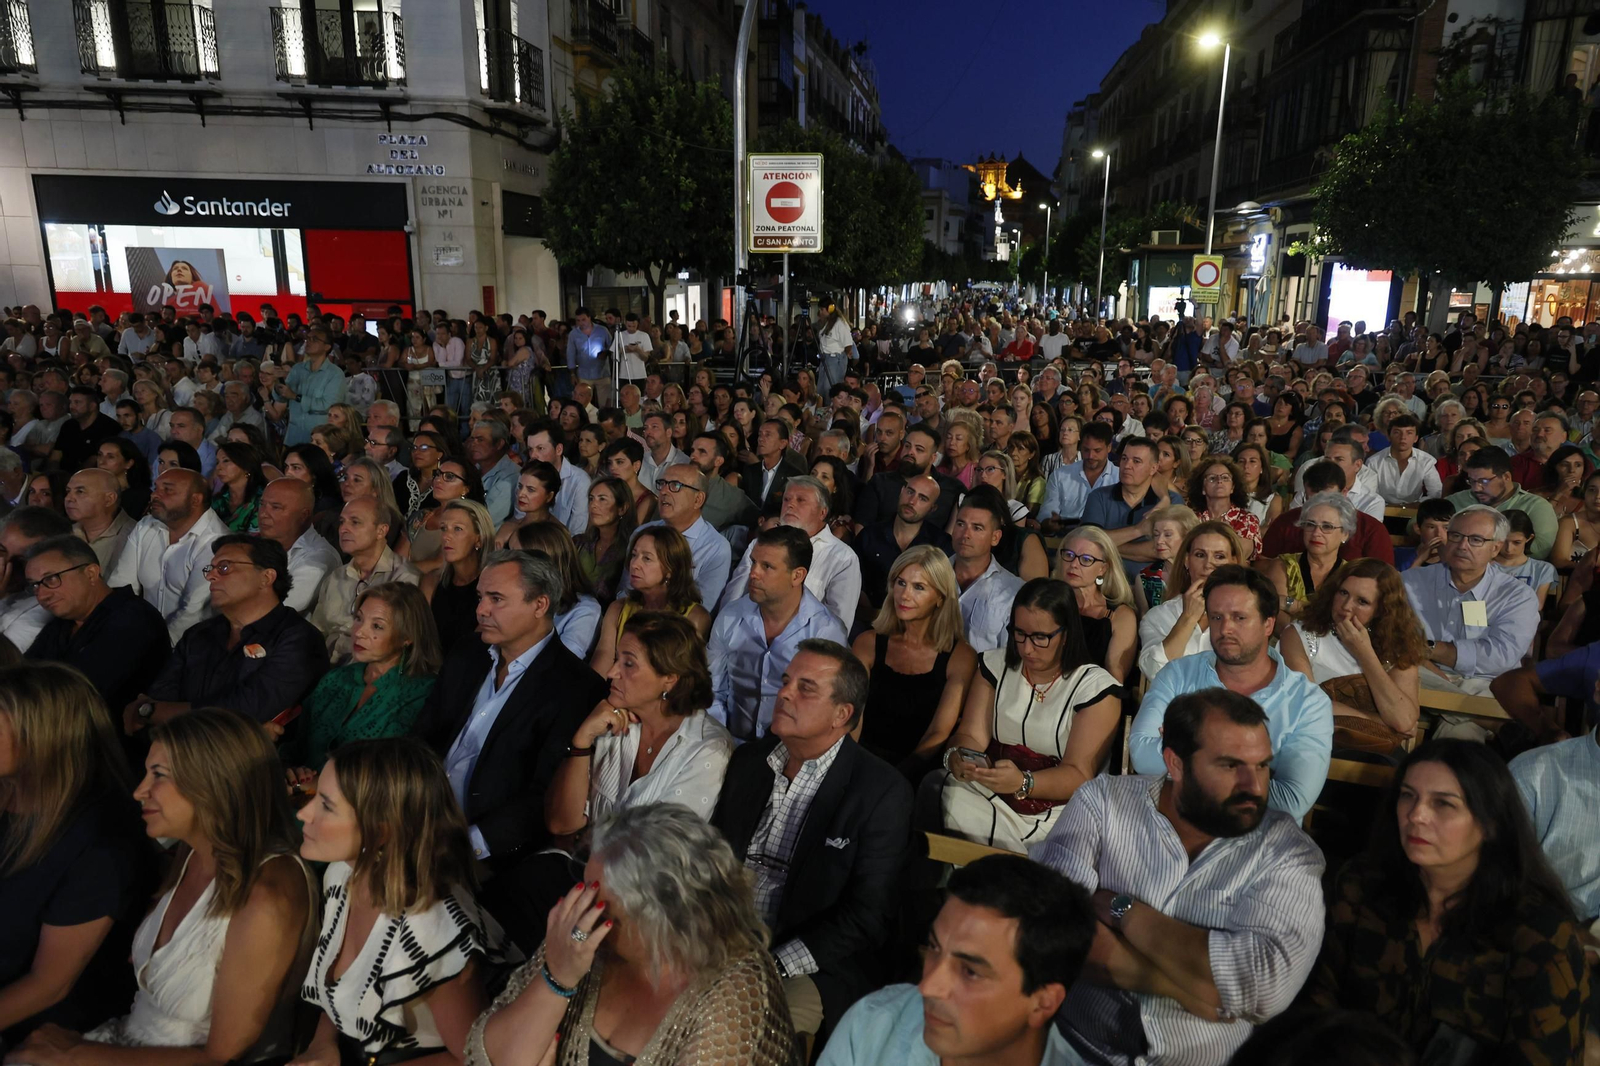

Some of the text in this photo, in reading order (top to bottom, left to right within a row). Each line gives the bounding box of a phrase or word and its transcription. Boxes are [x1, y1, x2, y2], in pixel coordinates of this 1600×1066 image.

[378, 134, 428, 146] PLAZA
[390, 149, 418, 160] DEL
[366, 164, 446, 176] ALTOZANO
[763, 171, 812, 180] ATENCIÓN
[421, 185, 468, 195] AGENCIA
[183, 196, 292, 217] Santander
[422, 197, 464, 207] URBANA
[146, 282, 214, 307] OPEN
